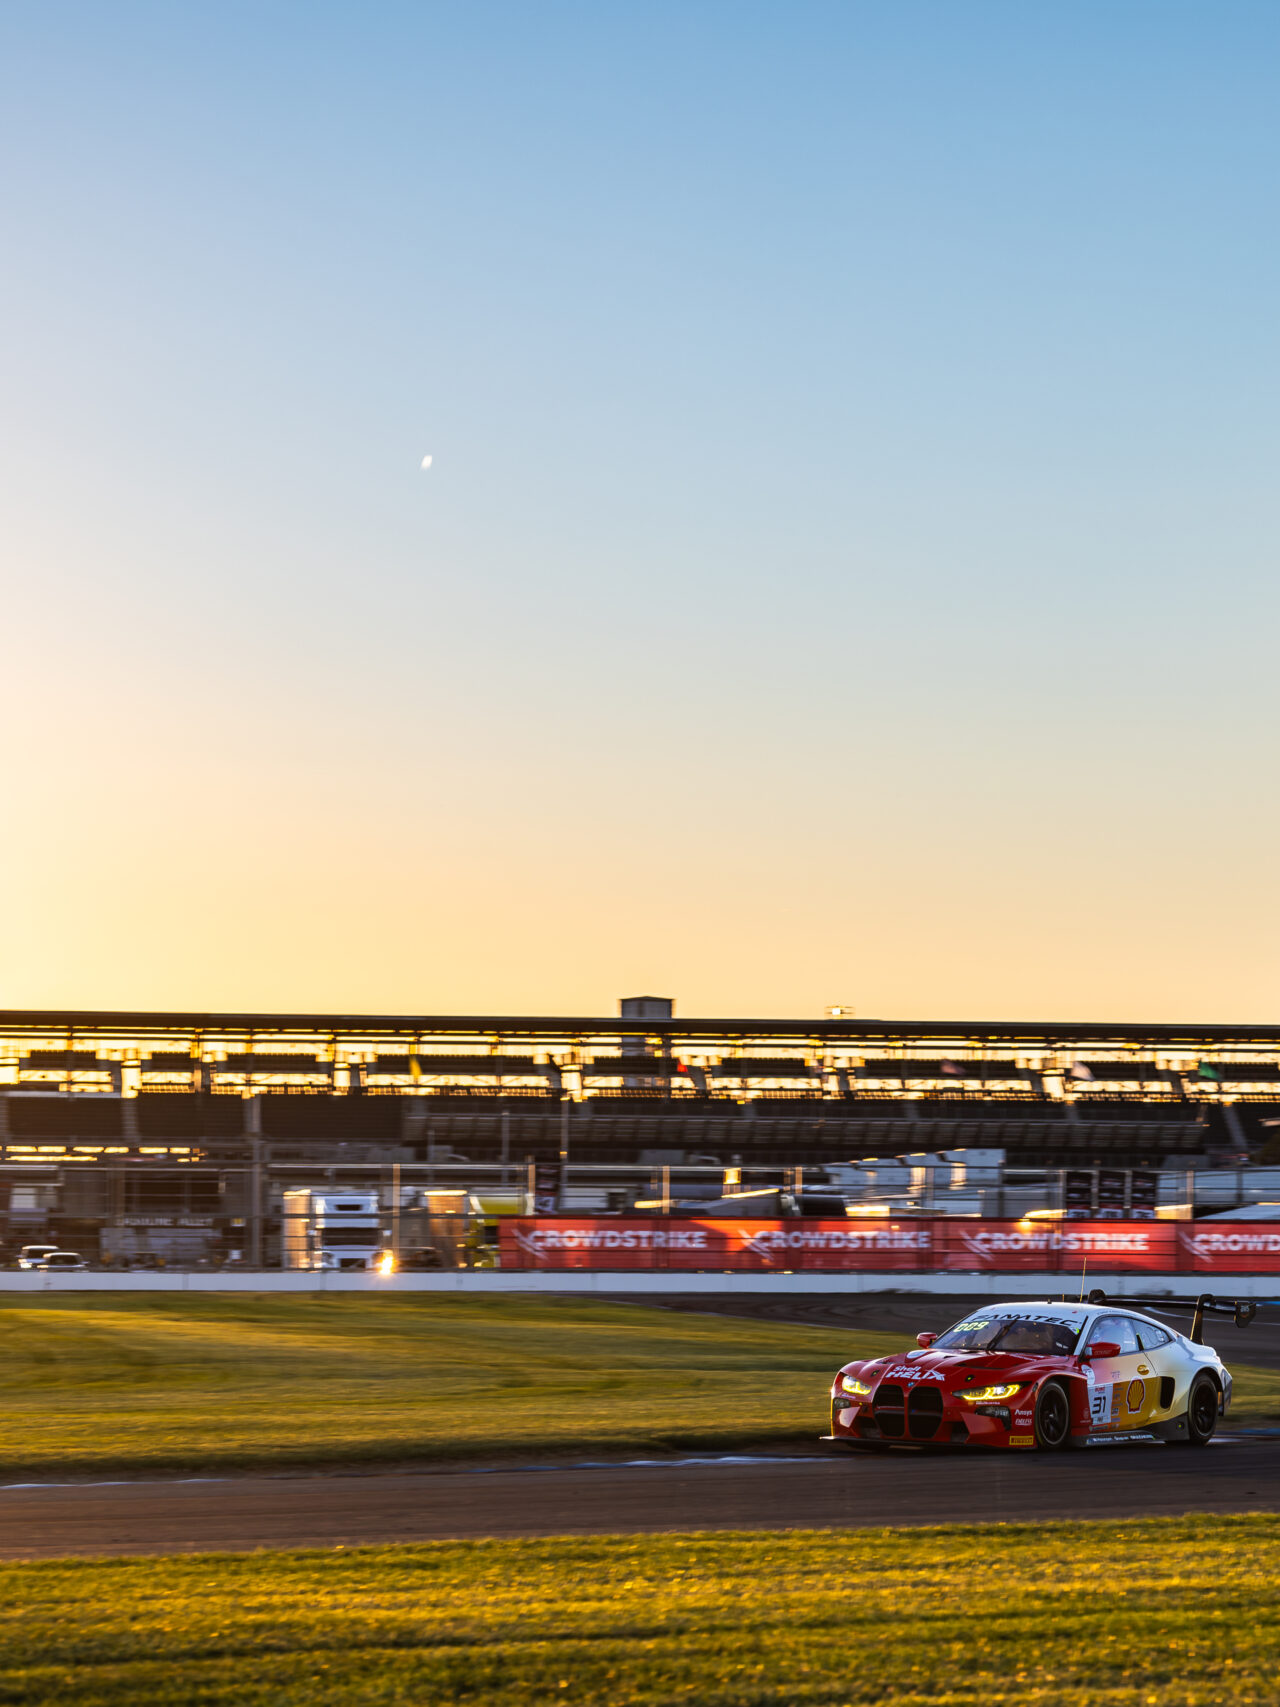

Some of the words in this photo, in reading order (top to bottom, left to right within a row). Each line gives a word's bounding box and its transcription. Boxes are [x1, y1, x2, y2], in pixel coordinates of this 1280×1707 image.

[529, 1230, 708, 1248] CROWDSTRIKE
[752, 1231, 932, 1249] CROWDSTRIKE
[977, 1232, 1150, 1251] CROWDSTRIKE
[953, 1321, 988, 1333] 009
[971, 1313, 1079, 1327] FANATEC
[885, 1369, 946, 1382] HELIX
[1014, 1408, 1033, 1417] Ansys
[1092, 1396, 1107, 1415] 31
